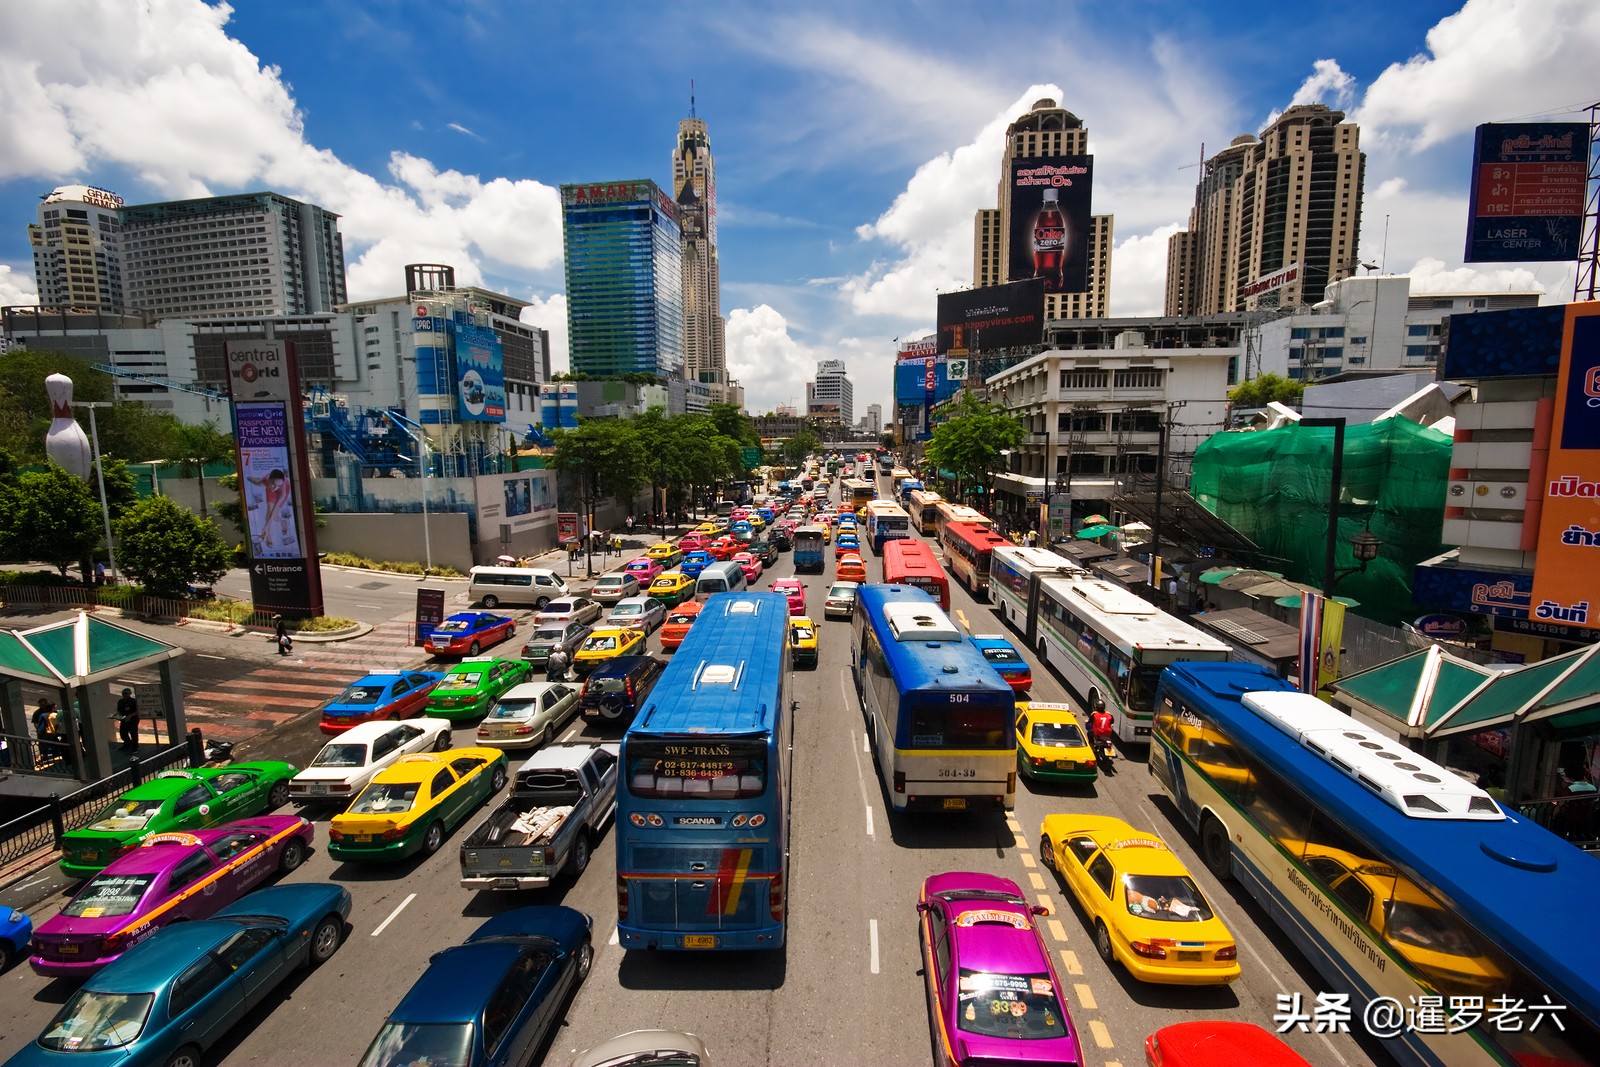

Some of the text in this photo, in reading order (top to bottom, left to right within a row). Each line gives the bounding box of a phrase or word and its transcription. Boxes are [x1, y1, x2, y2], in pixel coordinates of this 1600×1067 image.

[1051, 175, 1072, 187] 0%
[576, 184, 636, 199] AMARI
[83, 195, 122, 209] DIAMON
[87, 189, 124, 205] GRAND
[1487, 203, 1510, 212] กระ
[1035, 228, 1063, 240] Coke
[1487, 229, 1527, 239] LASER
[1503, 240, 1541, 248] CENTER
[1244, 279, 1271, 298] BANGKOK
[1271, 272, 1285, 287] CITY
[416, 319, 431, 331] CPAC
[230, 348, 280, 362] central
[240, 426, 284, 436] THE NEW
[240, 437, 247, 446] 7
[1535, 601, 1590, 623] วันที่
[950, 694, 970, 703] 504
[1100, 717, 1107, 729] 7
[1181, 705, 1202, 731] 7-3018
[664, 746, 730, 756] SWE-TRANS
[664, 761, 733, 770] 02-617-4481-2
[664, 769, 724, 777] 01-836-6439
[938, 768, 976, 777] 504-39
[679, 817, 716, 825] SCANIA
[98, 887, 122, 896] 1098
